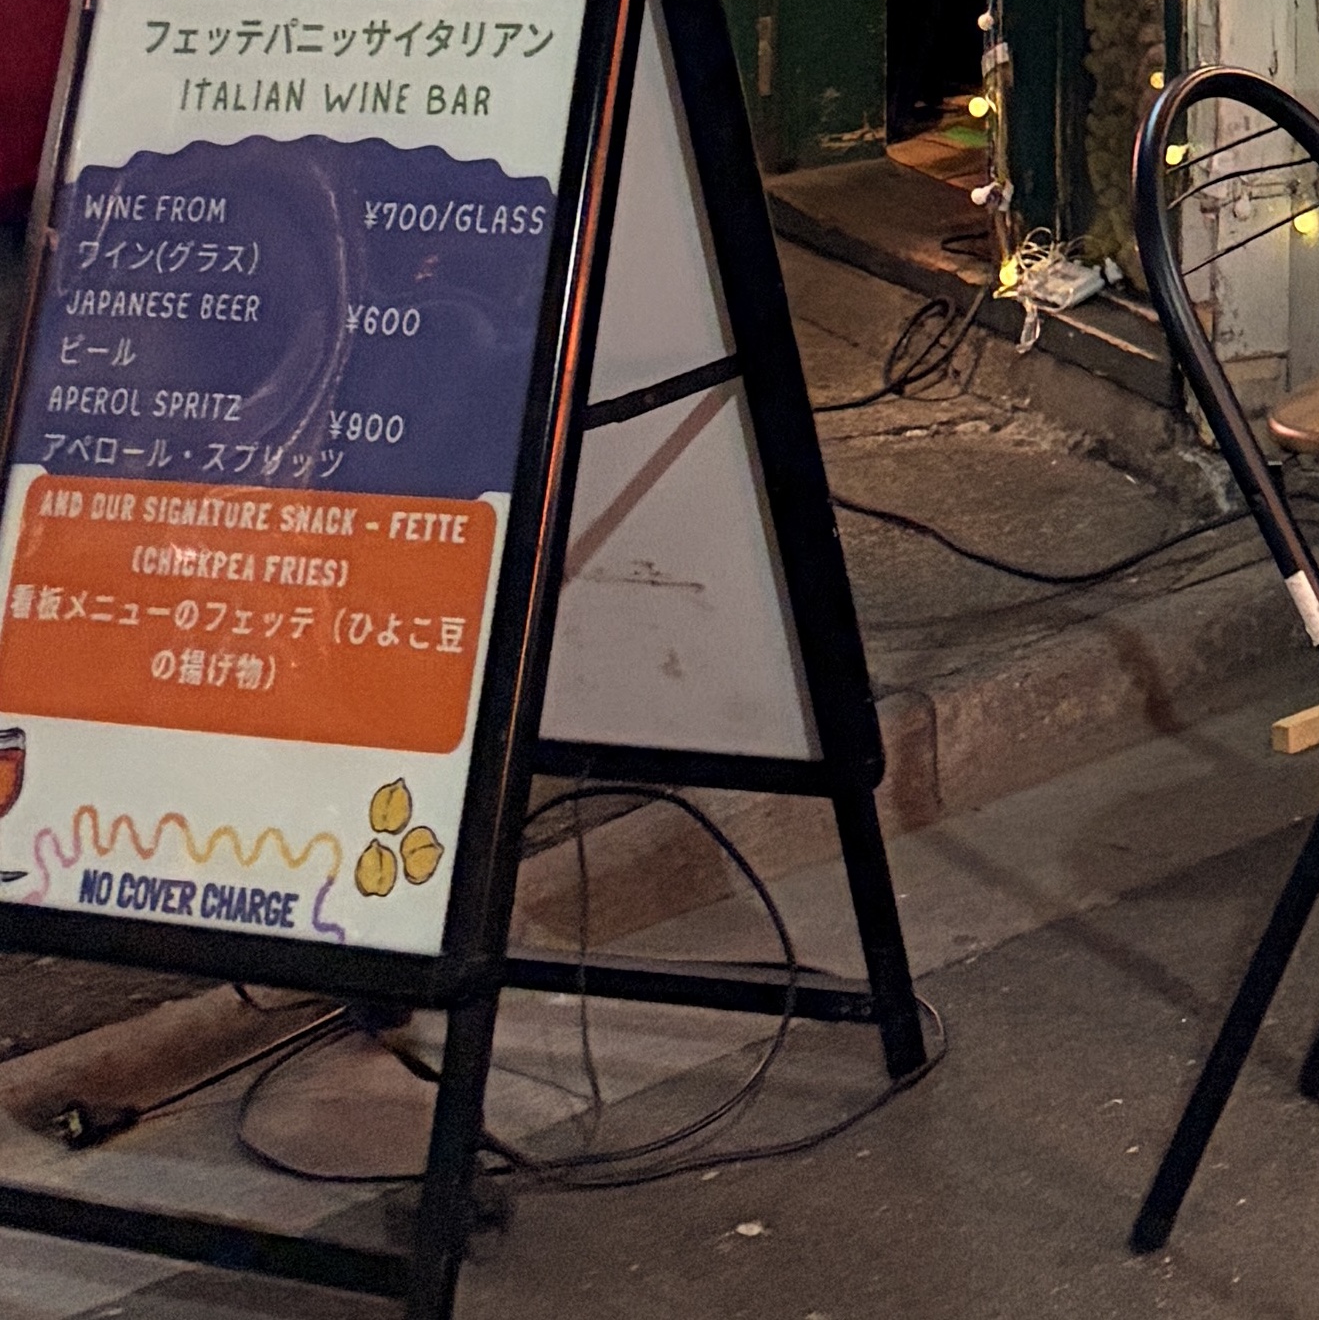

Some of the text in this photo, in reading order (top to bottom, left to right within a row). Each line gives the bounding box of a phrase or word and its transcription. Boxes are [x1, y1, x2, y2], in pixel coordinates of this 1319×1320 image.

[143, 17, 556, 60] フェッテパニッサイタリアン
[179, 77, 492, 117] ITALIAN WINE BAR
[84, 193, 227, 223] WINE FROM
[364, 200, 547, 236] ¥700/GLASS
[65, 289, 261, 323] JAPANESE BEER
[345, 303, 421, 338] ¥600
[60, 333, 137, 367] ビール
[47, 384, 243, 422] APEROL SPRITZ
[39, 489, 84, 519] AND
[90, 491, 137, 522] OUR
[143, 494, 273, 532] SIGNATURE
[279, 504, 358, 536] SNACK
[388, 510, 470, 544] FETTE
[262, 554, 350, 588] FRIES)
[80, 868, 300, 930] NO COVER CHARGE
